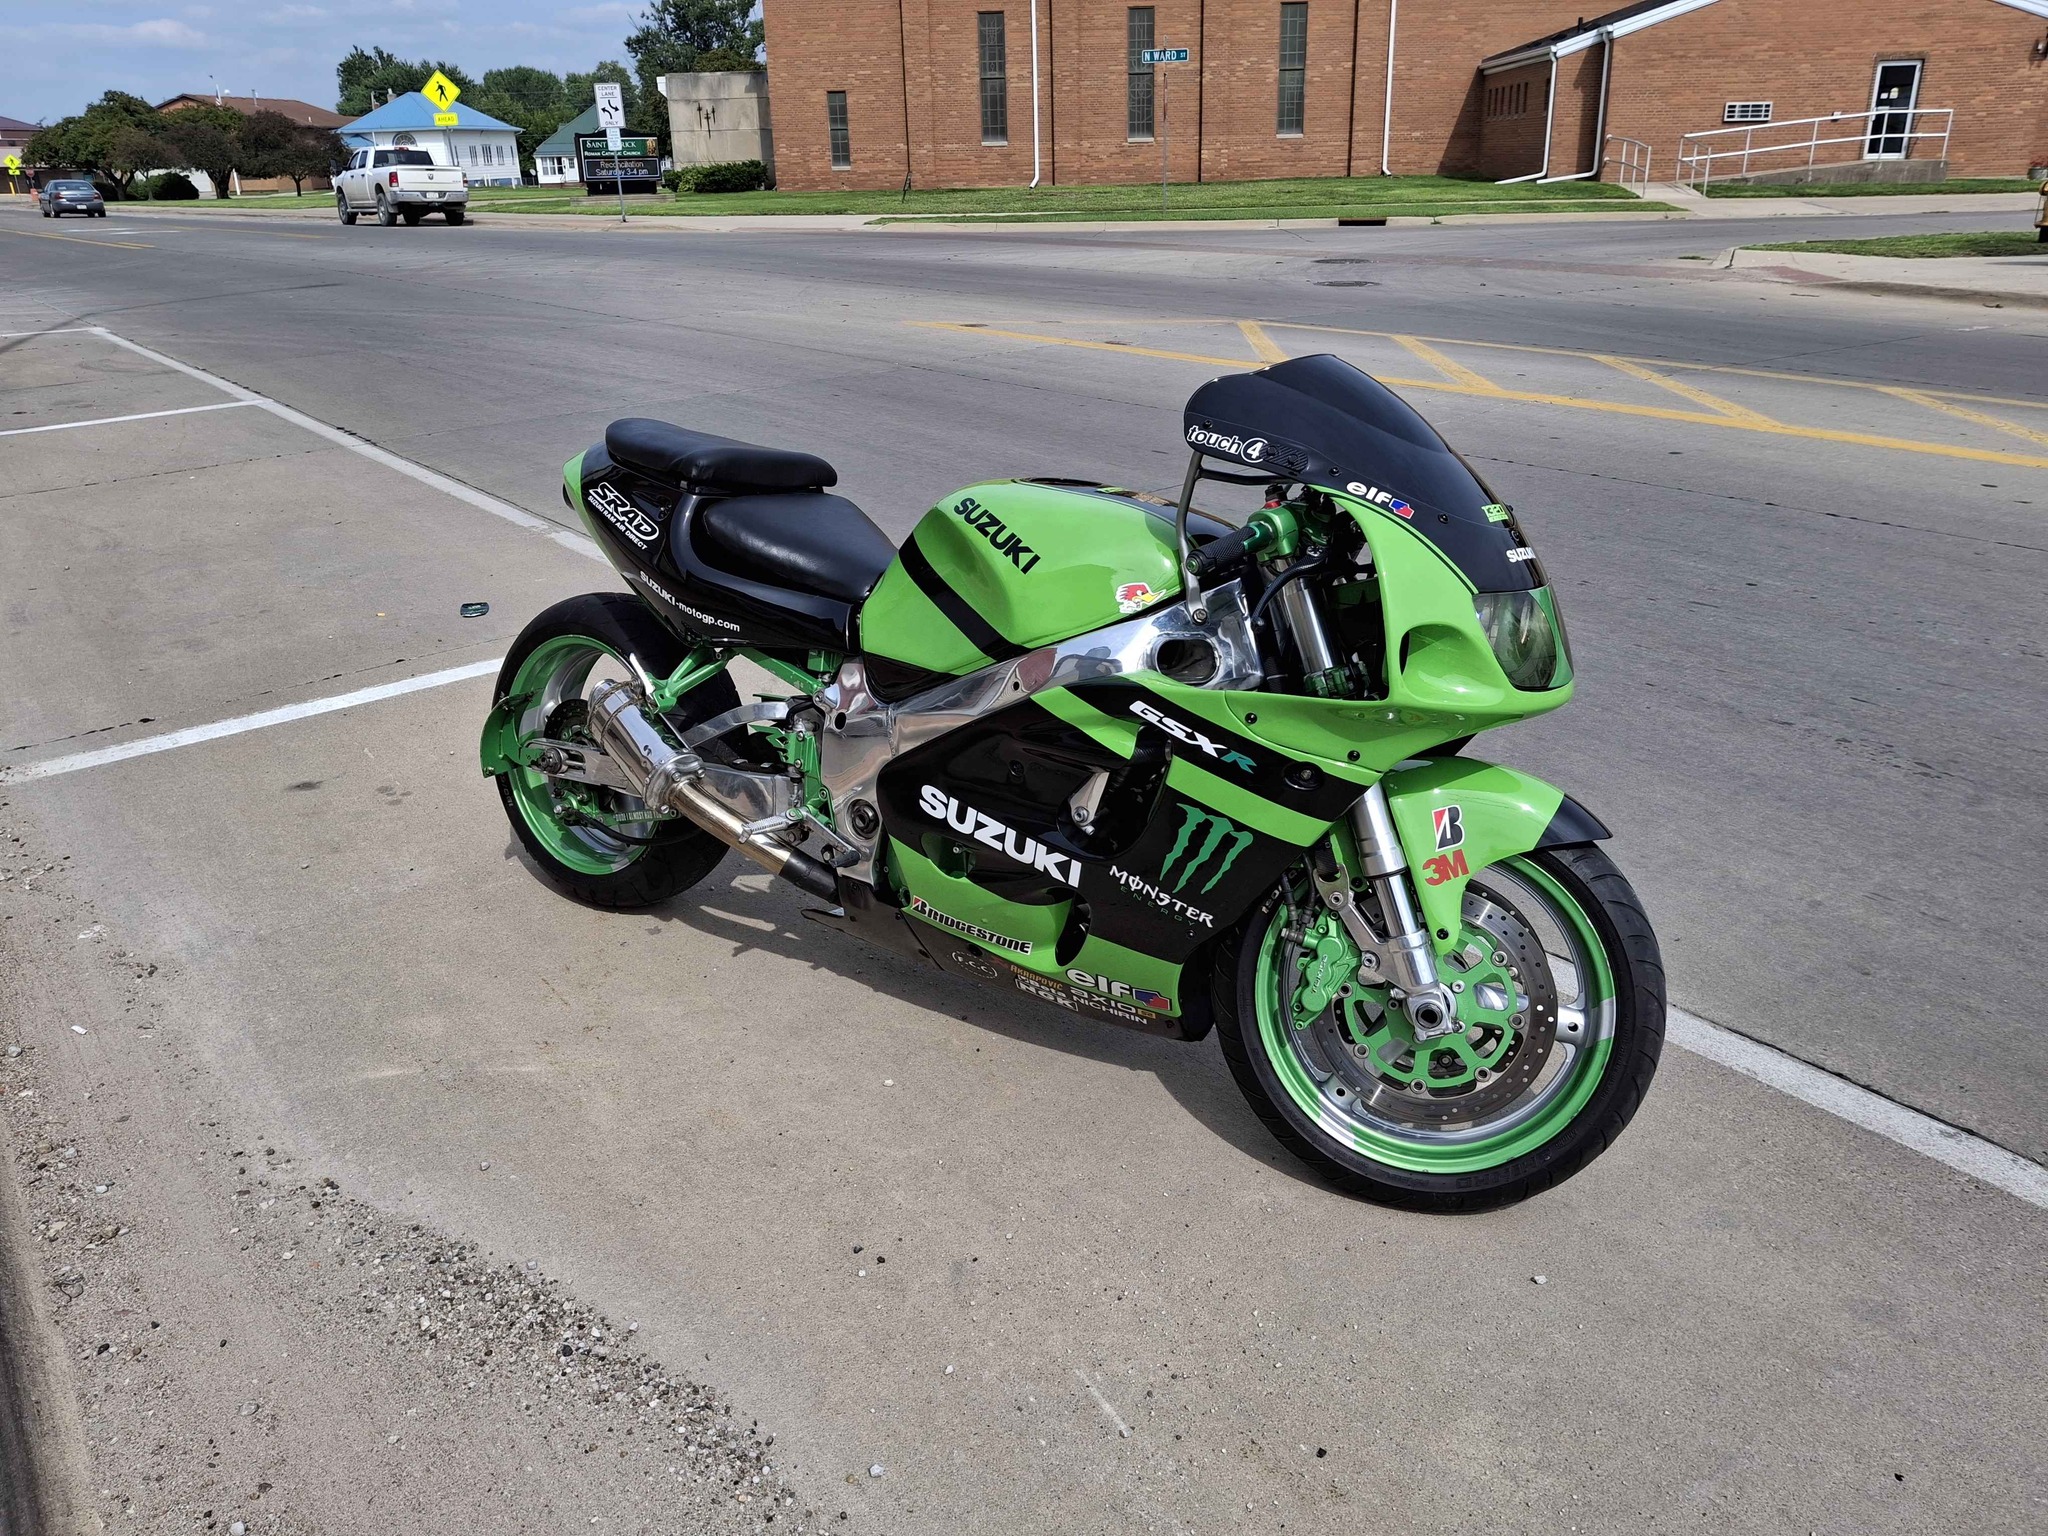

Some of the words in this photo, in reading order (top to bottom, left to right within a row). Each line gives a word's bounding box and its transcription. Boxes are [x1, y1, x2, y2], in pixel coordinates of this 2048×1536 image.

[1144, 51, 1150, 61] N
[1153, 50, 1177, 60] WARD
[586, 140, 606, 148] SAINT
[626, 168, 637, 176] 3-4
[589, 482, 659, 540] SRAD
[1346, 481, 1396, 504] elf
[587, 495, 605, 513] SUZUKI
[602, 509, 617, 524] RAM
[615, 521, 626, 532] AIR
[625, 530, 648, 550] DIRECT
[953, 497, 1041, 575] SUZUKI
[919, 784, 1082, 888] SUZUKI
[1422, 848, 1470, 886] 3M
[911, 894, 1033, 955] BRIDGESTONE
[1120, 885, 1195, 926] ENERGY
[1066, 968, 1131, 997] elf
[1073, 995, 1147, 1025] NICHIRIN
